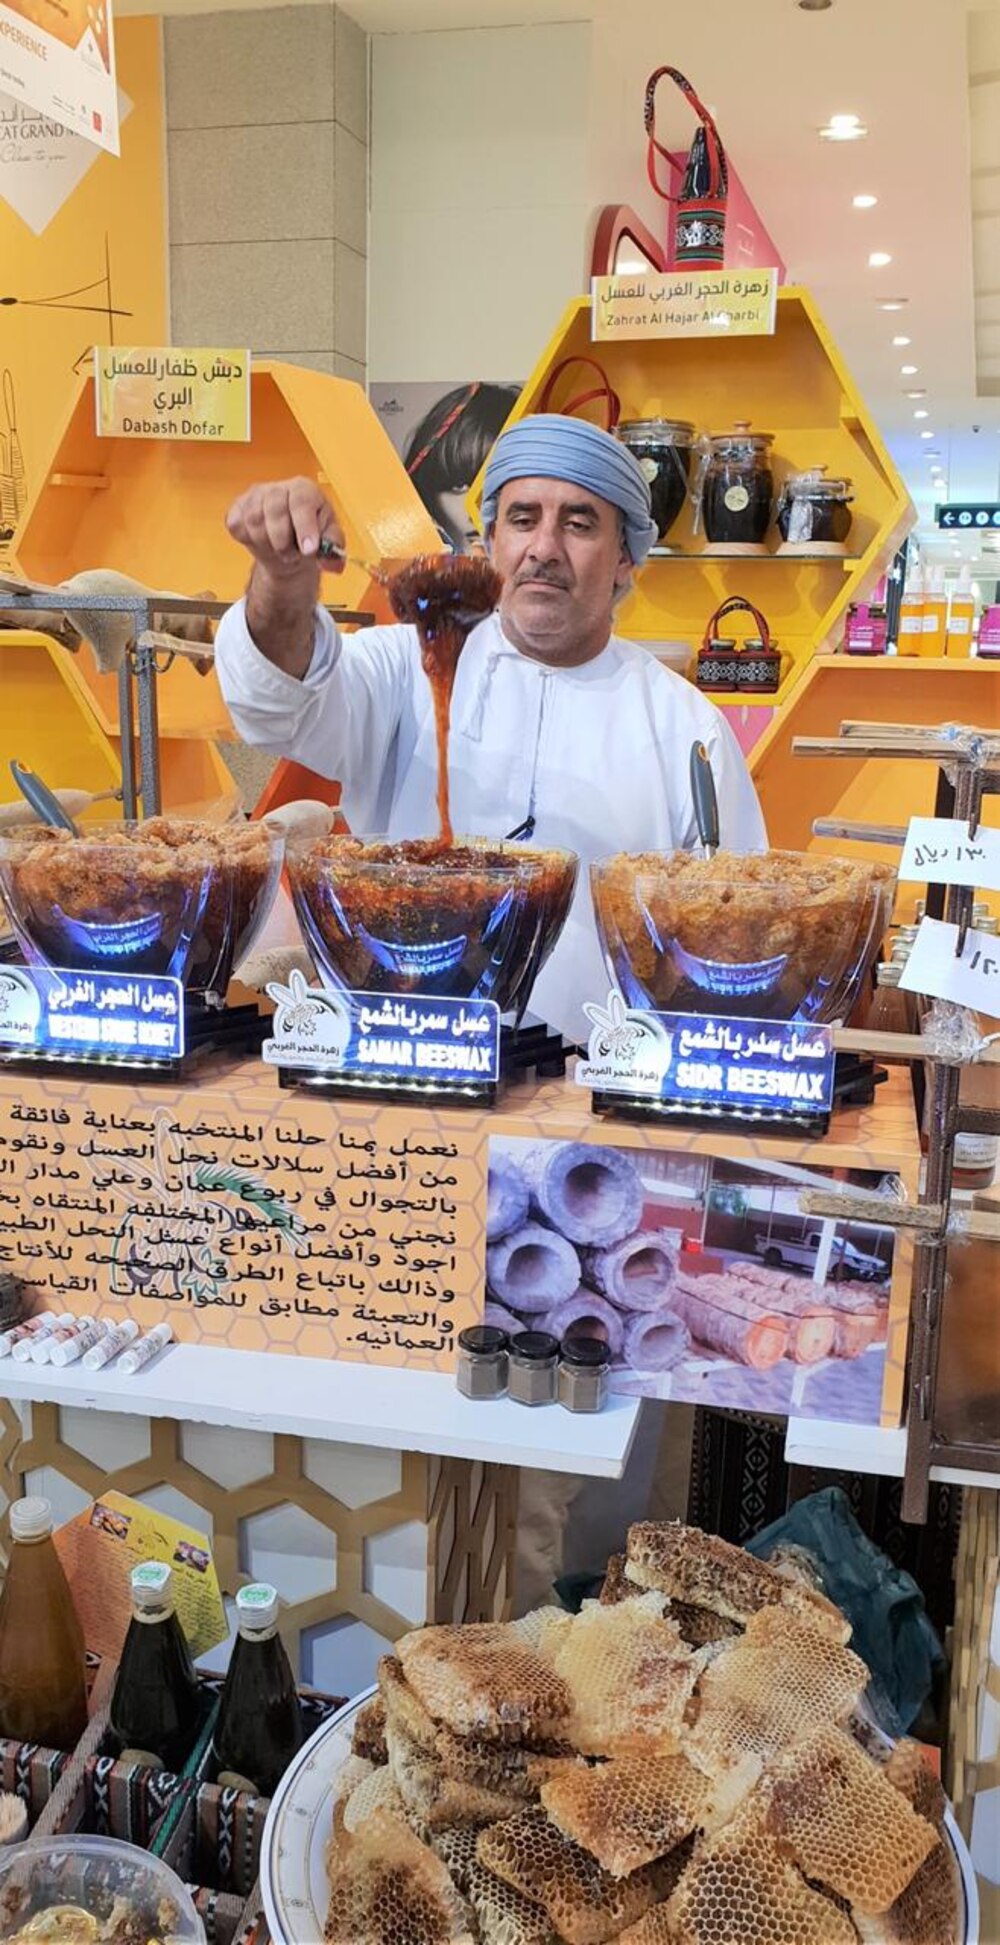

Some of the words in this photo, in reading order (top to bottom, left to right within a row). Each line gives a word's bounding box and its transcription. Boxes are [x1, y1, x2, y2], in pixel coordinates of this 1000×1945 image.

[20, 122, 64, 139] GRAND
[601, 284, 645, 303] للعسل
[649, 282, 693, 305] الغربي
[697, 280, 729, 299] الحجر
[733, 279, 769, 297] زهرة
[607, 312, 647, 326] Zahrat
[650, 312, 662, 324] Al
[665, 311, 699, 326] Hajar
[202, 356, 242, 383] دبش
[153, 387, 193, 414] البري
[122, 417, 177, 434] Dabash
[181, 420, 225, 436] Dofar
[48, 980, 95, 1010] الغربي
[96, 984, 140, 1010] الحجر
[142, 986, 178, 1013] عسل
[451, 1007, 491, 1036] عسل
[357, 1038, 413, 1066] SAMAR
[415, 1042, 492, 1072] BEESWAX
[782, 1032, 826, 1062] عسل
[676, 1061, 723, 1091] SIDR
[726, 1066, 825, 1100] BEESWAX
[10, 1104, 71, 1124] فائقة
[83, 1110, 156, 1138] بعناية
[168, 1122, 263, 1142] المنتخبه
[275, 1126, 326, 1145] حلنا
[77, 1139, 155, 1160] العسل
[167, 1146, 218, 1165] نحل
[389, 1138, 458, 1157] نعمل
[25, 1162, 80, 1180] مدار
[231, 1154, 324, 1174] سلالات
[336, 1160, 408, 1182] أفضل
[92, 1168, 152, 1191] وعلي
[165, 1174, 227, 1193] عمان
[419, 1170, 458, 1188] من
[32, 1192, 115, 1215] المنتقاه
[240, 1183, 302, 1204] ربوع
[314, 1186, 337, 1211] في
[127, 1202, 223, 1225] المختلفه
[348, 1190, 457, 1220] بالتجوال
[67, 1220, 134, 1239] النحل
[235, 1208, 326, 1235] مراعيها
[338, 1222, 376, 1240] من
[219, 1233, 282, 1256] أنواع
[389, 1230, 456, 1250] نجني
[294, 1241, 381, 1267] وأفضل
[393, 1253, 456, 1274] اجود
[206, 1260, 283, 1282] الطرق
[296, 1270, 366, 1295] باتباع
[378, 1278, 455, 1303] وذالك
[110, 1282, 247, 1308] للمواصفات
[259, 1297, 339, 1318] مطابق
[352, 1303, 454, 1334] والتعبئة
